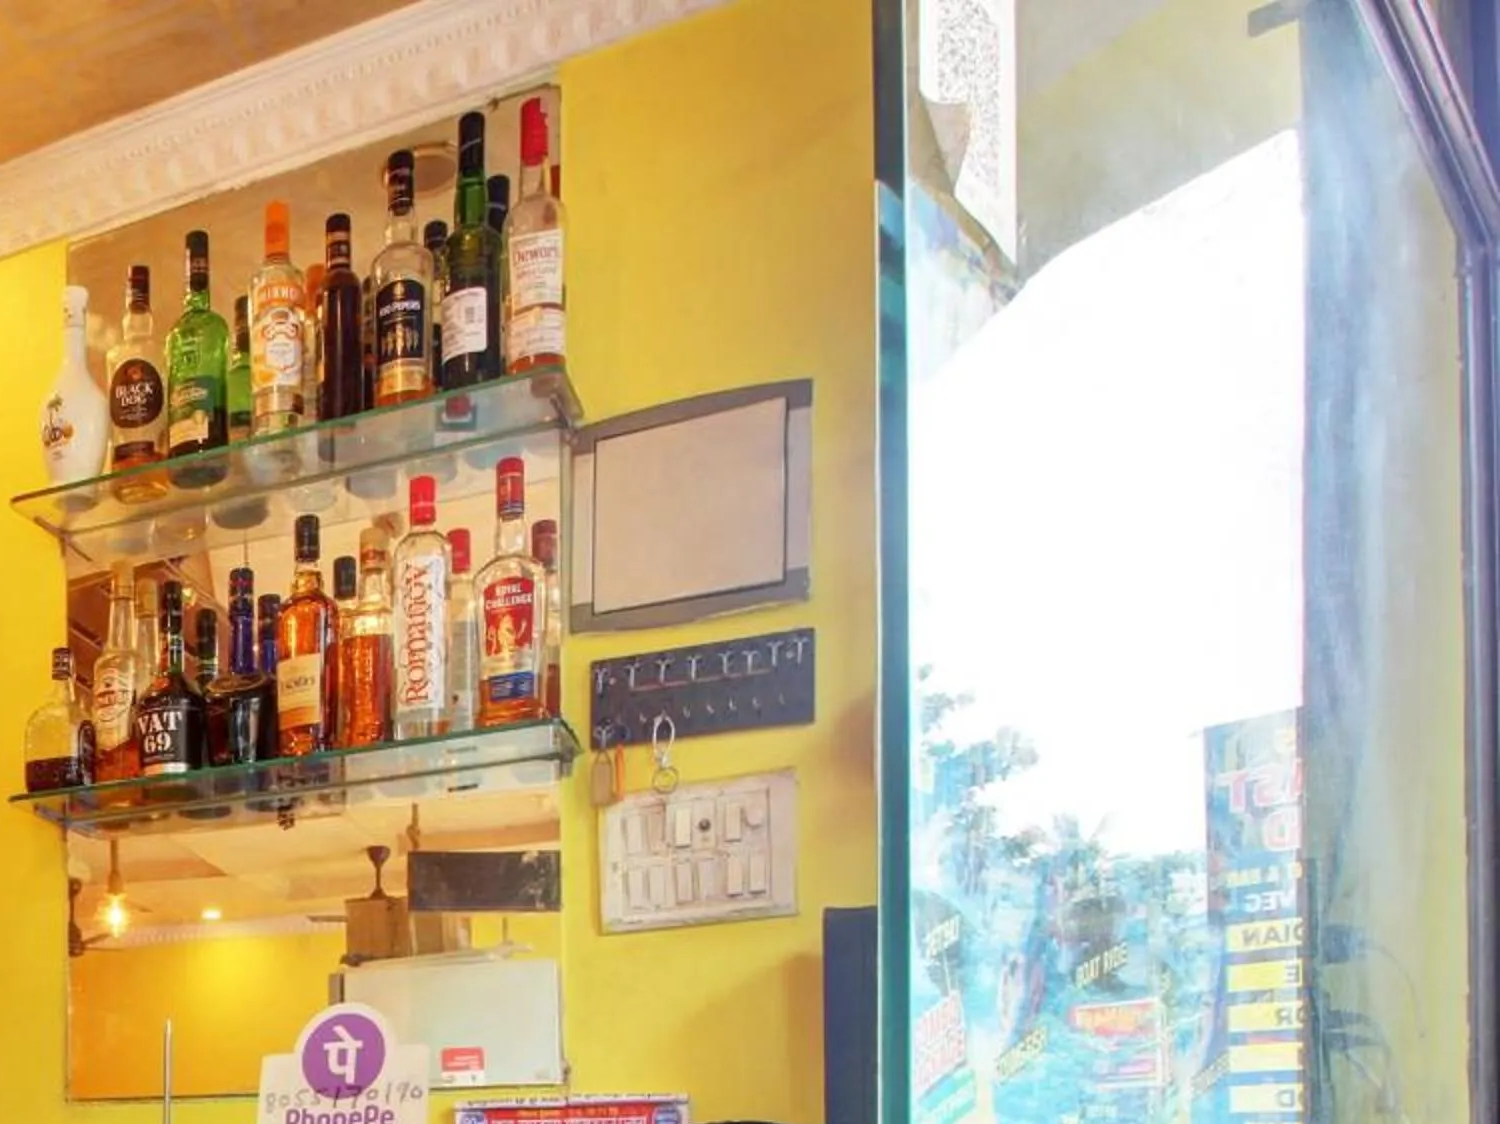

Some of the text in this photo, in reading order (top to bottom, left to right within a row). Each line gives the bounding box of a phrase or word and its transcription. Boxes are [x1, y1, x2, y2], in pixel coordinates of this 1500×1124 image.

[115, 381, 153, 399] BLACK
[121, 392, 147, 408] DOG
[495, 582, 523, 597] ROYAL
[485, 592, 534, 610] CHALLENGE
[137, 710, 183, 735] VAT
[143, 731, 172, 754] 69
